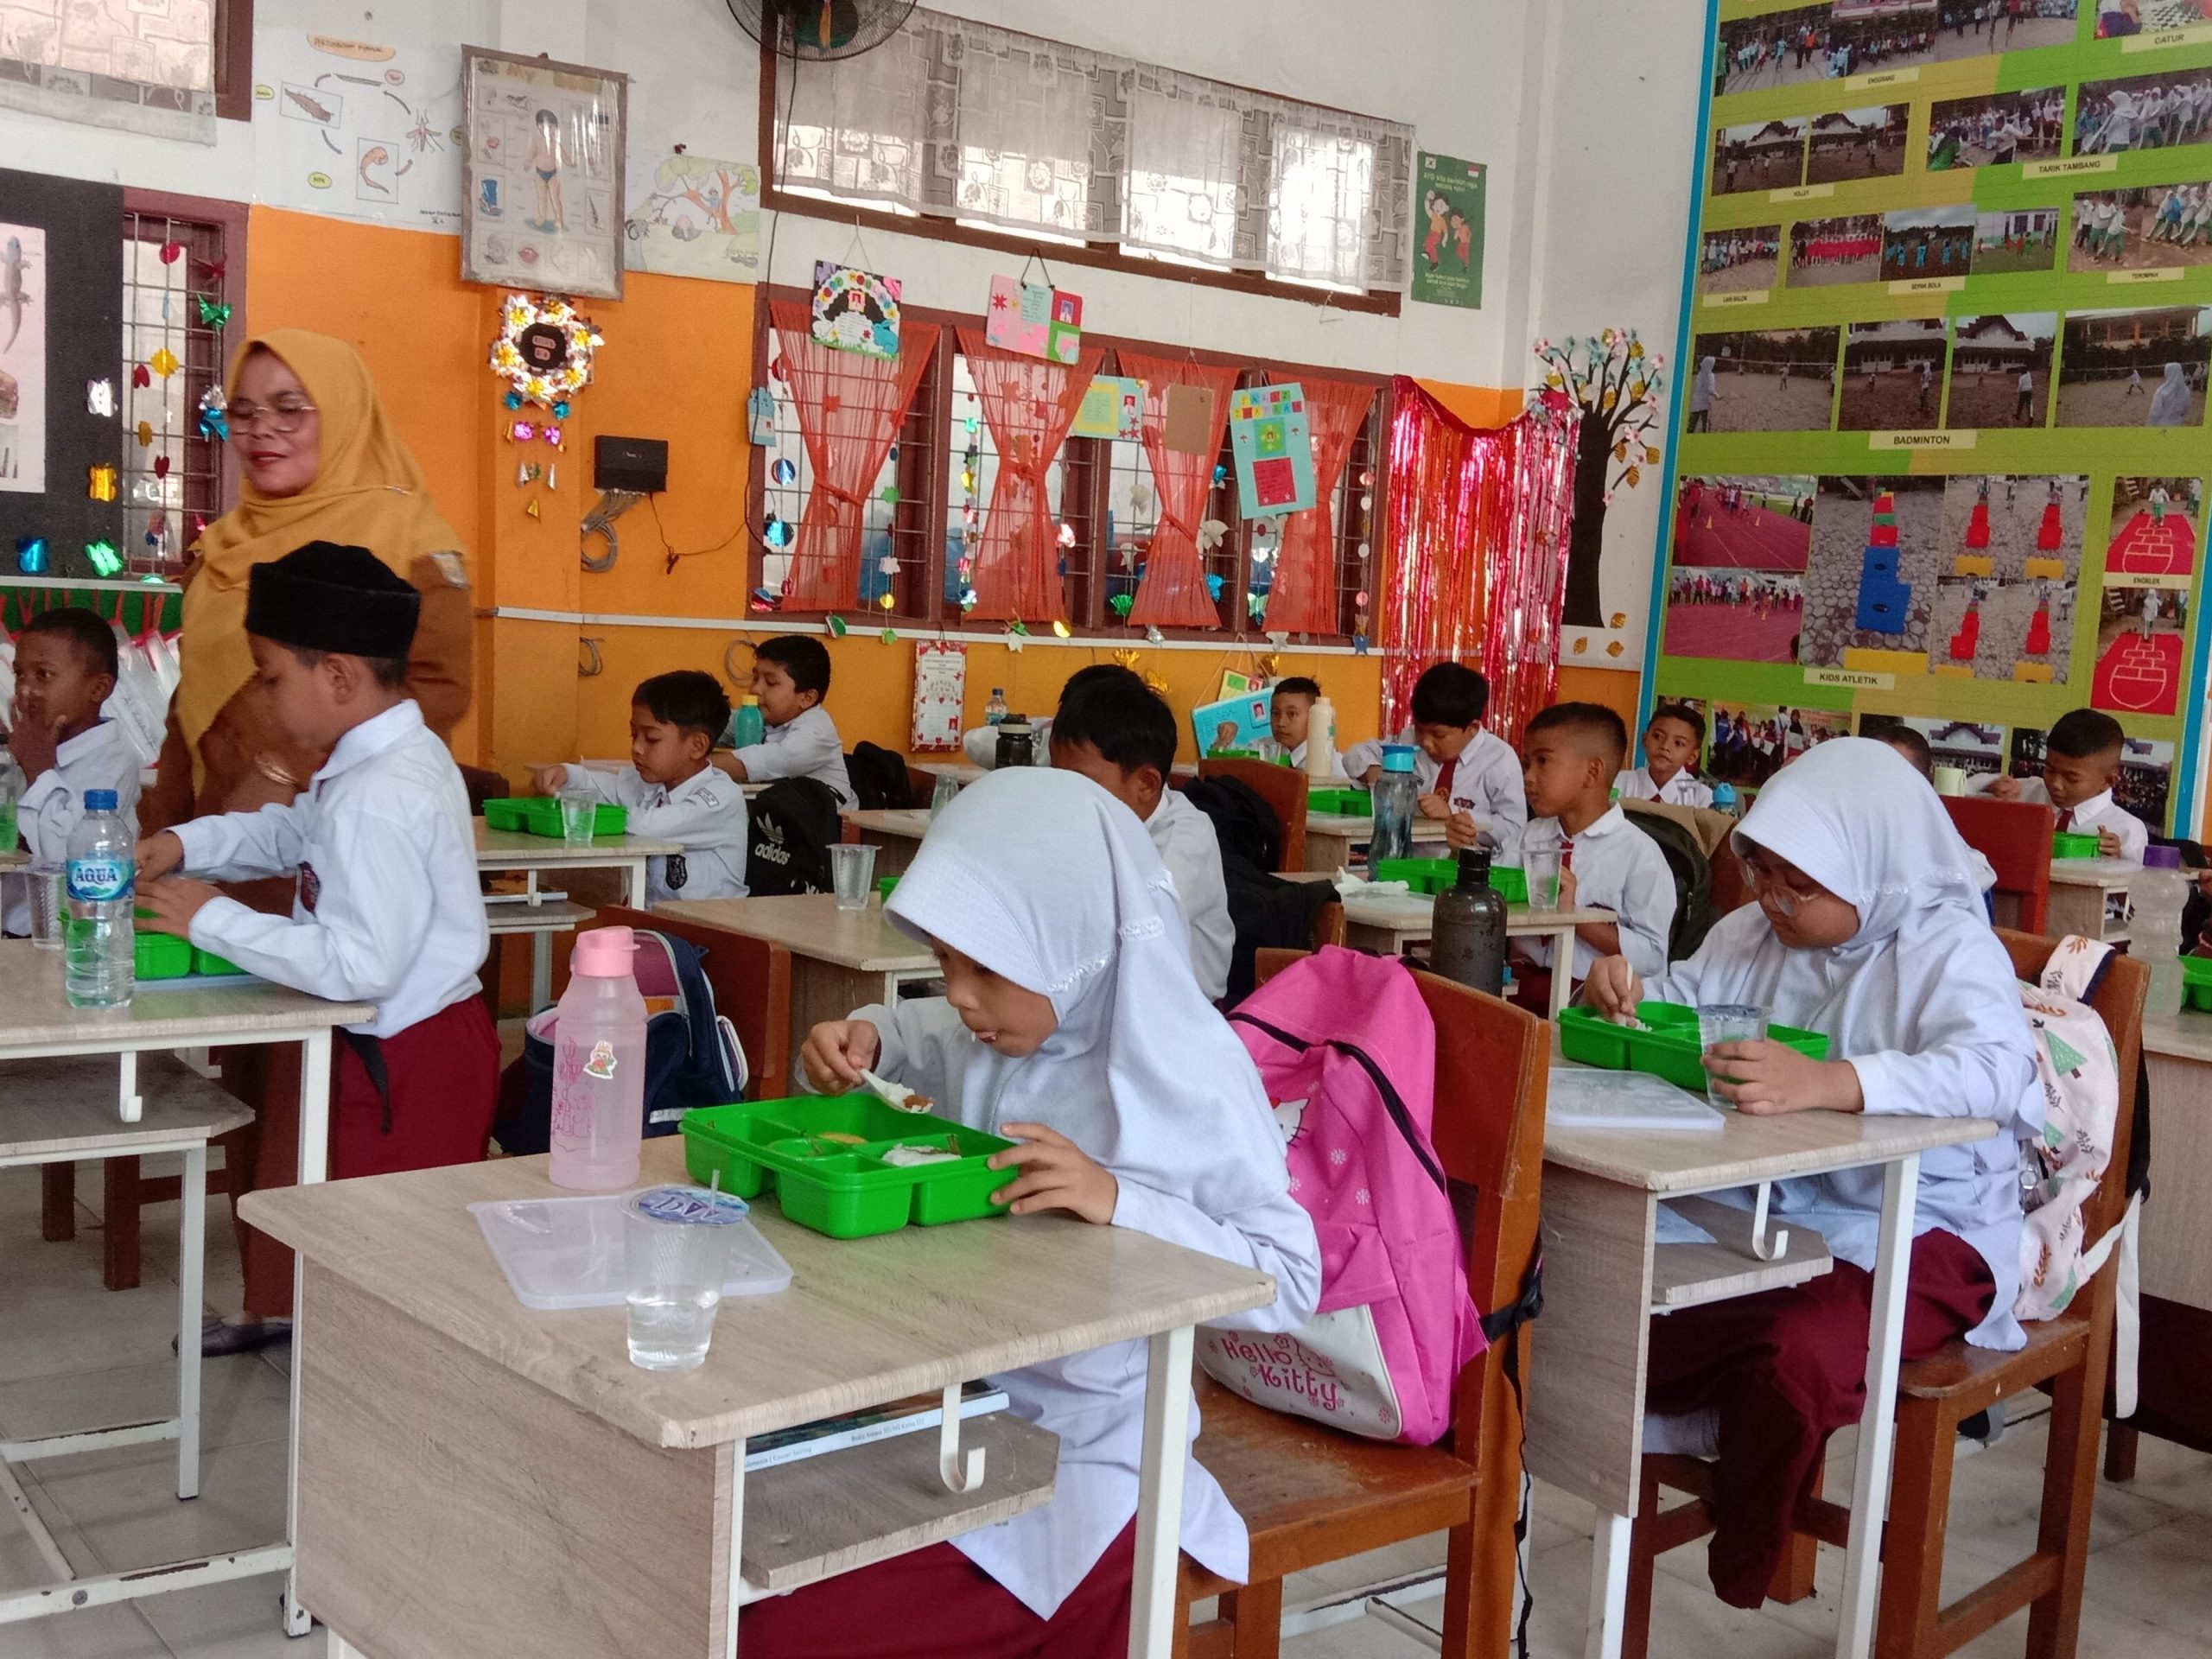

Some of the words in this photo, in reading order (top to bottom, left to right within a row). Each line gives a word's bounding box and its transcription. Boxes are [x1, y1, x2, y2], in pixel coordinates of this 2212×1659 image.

[2154, 34, 2184, 45] CATUR
[2039, 164, 2061, 173] TARIK
[2063, 161, 2101, 171] TAMBANG
[1893, 435, 1950, 445] BADMINTON
[1819, 672, 1840, 682] KIDS
[1841, 675, 1878, 685] ATLETIK
[754, 842, 791, 866] adidas
[75, 868, 118, 886] AQUA
[1220, 1338, 1293, 1365] Hello
[1258, 1363, 1338, 1411] Kitty
